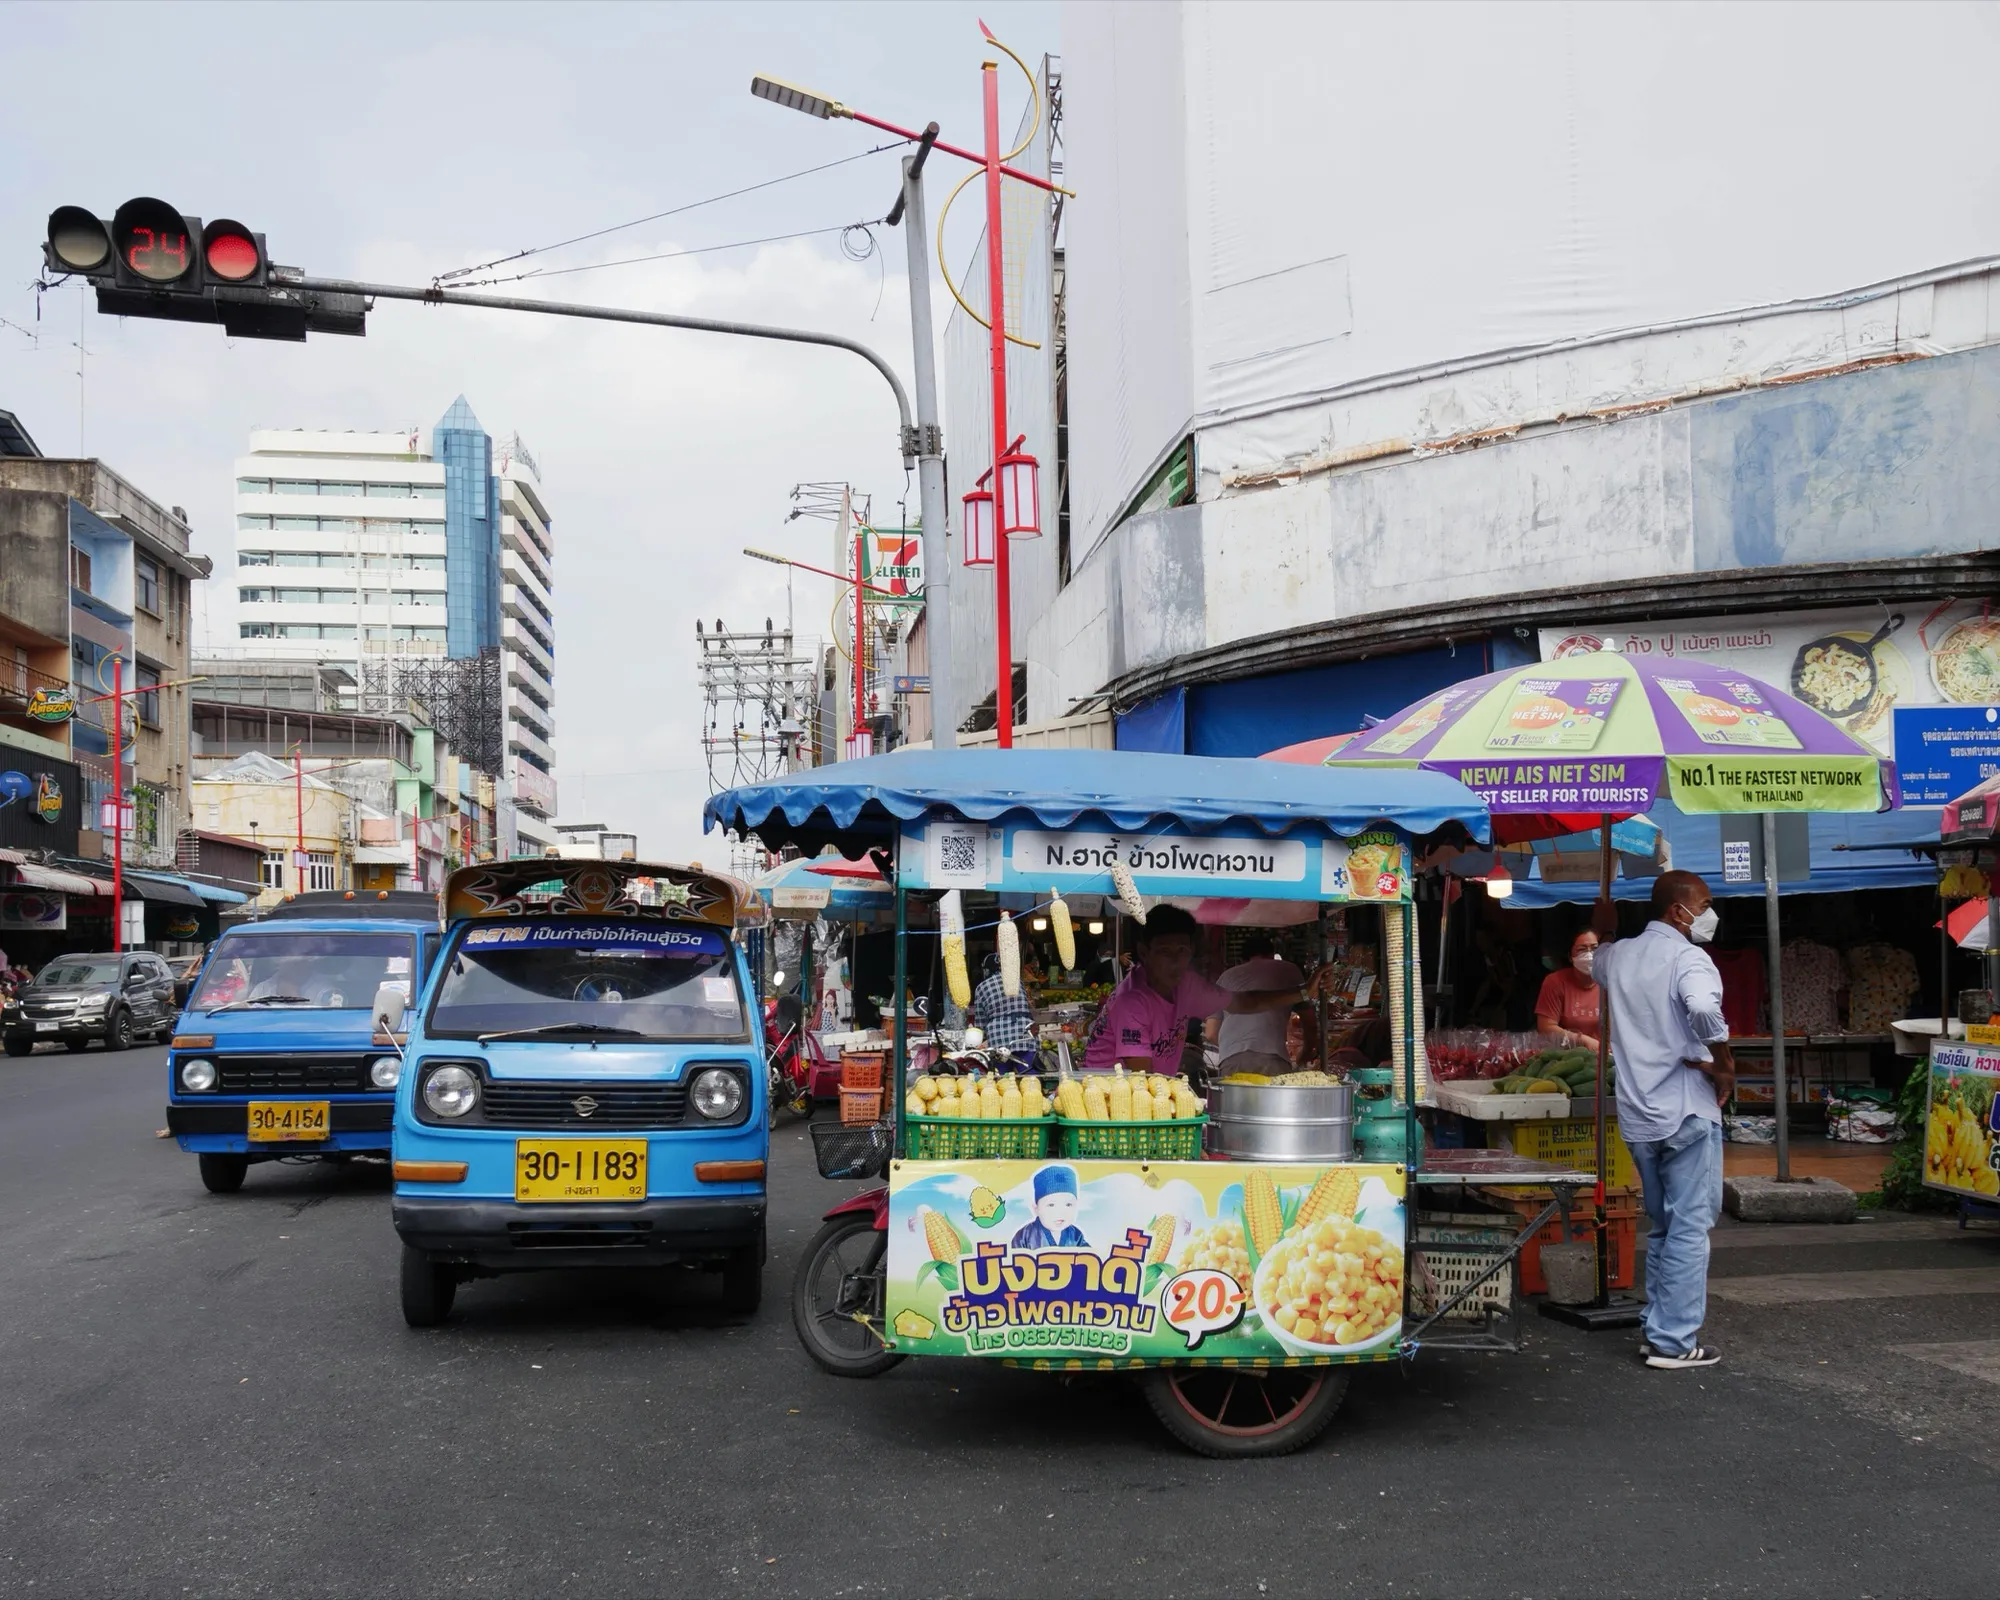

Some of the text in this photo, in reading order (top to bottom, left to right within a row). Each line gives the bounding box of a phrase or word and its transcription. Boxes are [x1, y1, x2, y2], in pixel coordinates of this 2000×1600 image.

[129, 227, 186, 270] 24
[1660, 633, 1675, 658] ปู
[1682, 634, 1720, 650] เน้นๆ
[1726, 629, 1772, 648] แนะนำ
[1584, 693, 1614, 705] 5G
[1512, 712, 1565, 720] NET SIM
[1490, 734, 1521, 746] NO.1
[1461, 763, 1626, 786] NEW! AIS NET SIM
[1681, 763, 1862, 787] NO.1 THE FASTEST NETWORK
[1474, 787, 1649, 805] EST SELLER FOR TOURISTS
[1742, 790, 1804, 803] IN THAILAND
[1128, 845, 1274, 874] ข้าวโพดหวาน
[1737, 854, 1743, 863] 6
[252, 1108, 325, 1129] 30-4154
[524, 1150, 639, 1181] 30-1183
[564, 1185, 600, 1195] สงขลา
[628, 1185, 643, 1195] 92
[963, 1228, 1152, 1297] บังฮาดี้
[944, 1291, 1156, 1334] ข้าวโพดหวาน
[1007, 1326, 1128, 1351] 0837511926
